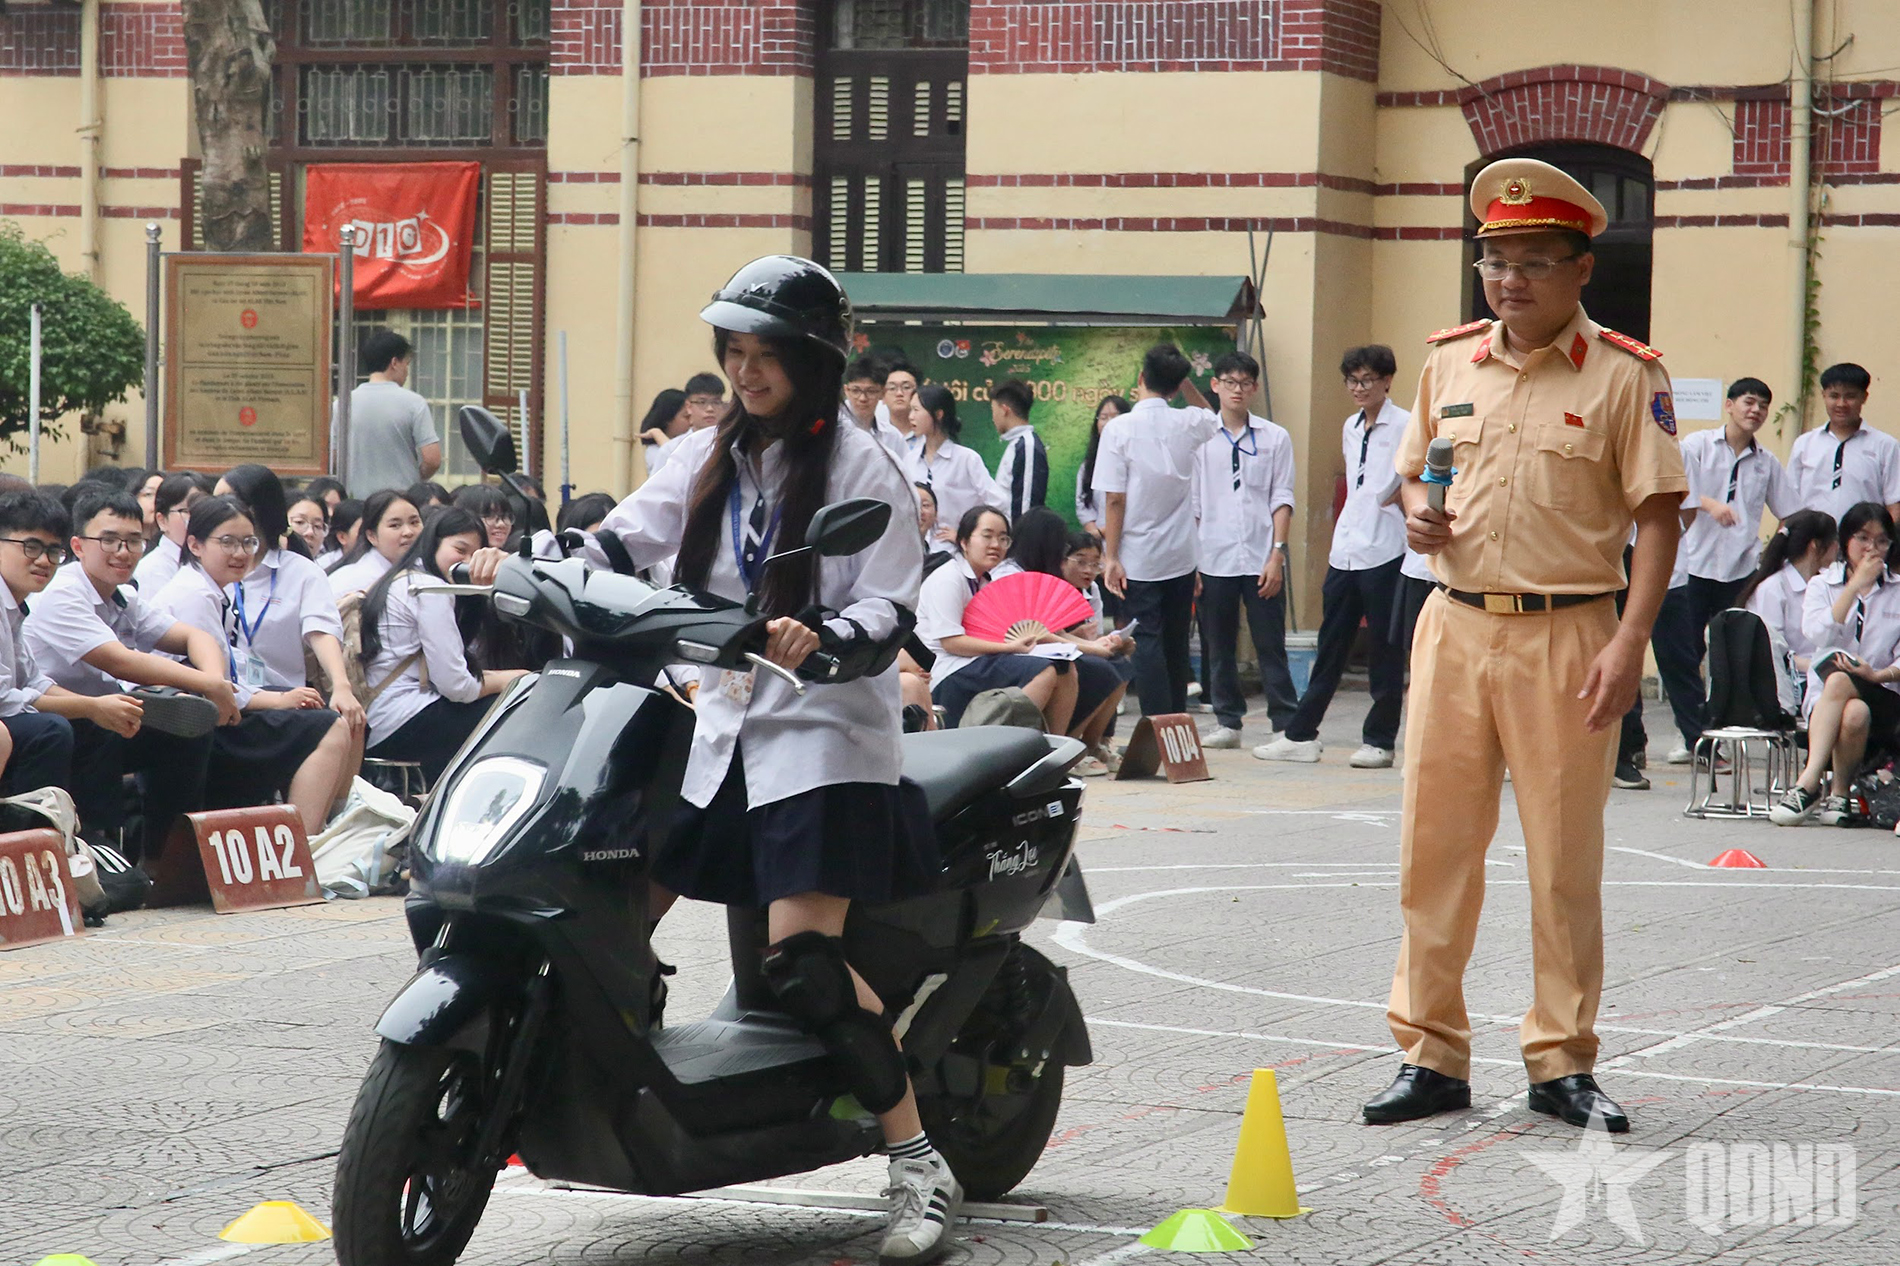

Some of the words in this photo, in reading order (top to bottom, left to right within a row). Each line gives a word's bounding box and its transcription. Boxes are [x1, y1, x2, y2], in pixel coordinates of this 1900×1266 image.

[944, 378, 968, 402] ôi
[547, 669, 581, 679] HONDA
[208, 829, 254, 885] 10
[254, 824, 303, 881] A2
[583, 848, 640, 861] HONDA
[24, 850, 67, 913] A3
